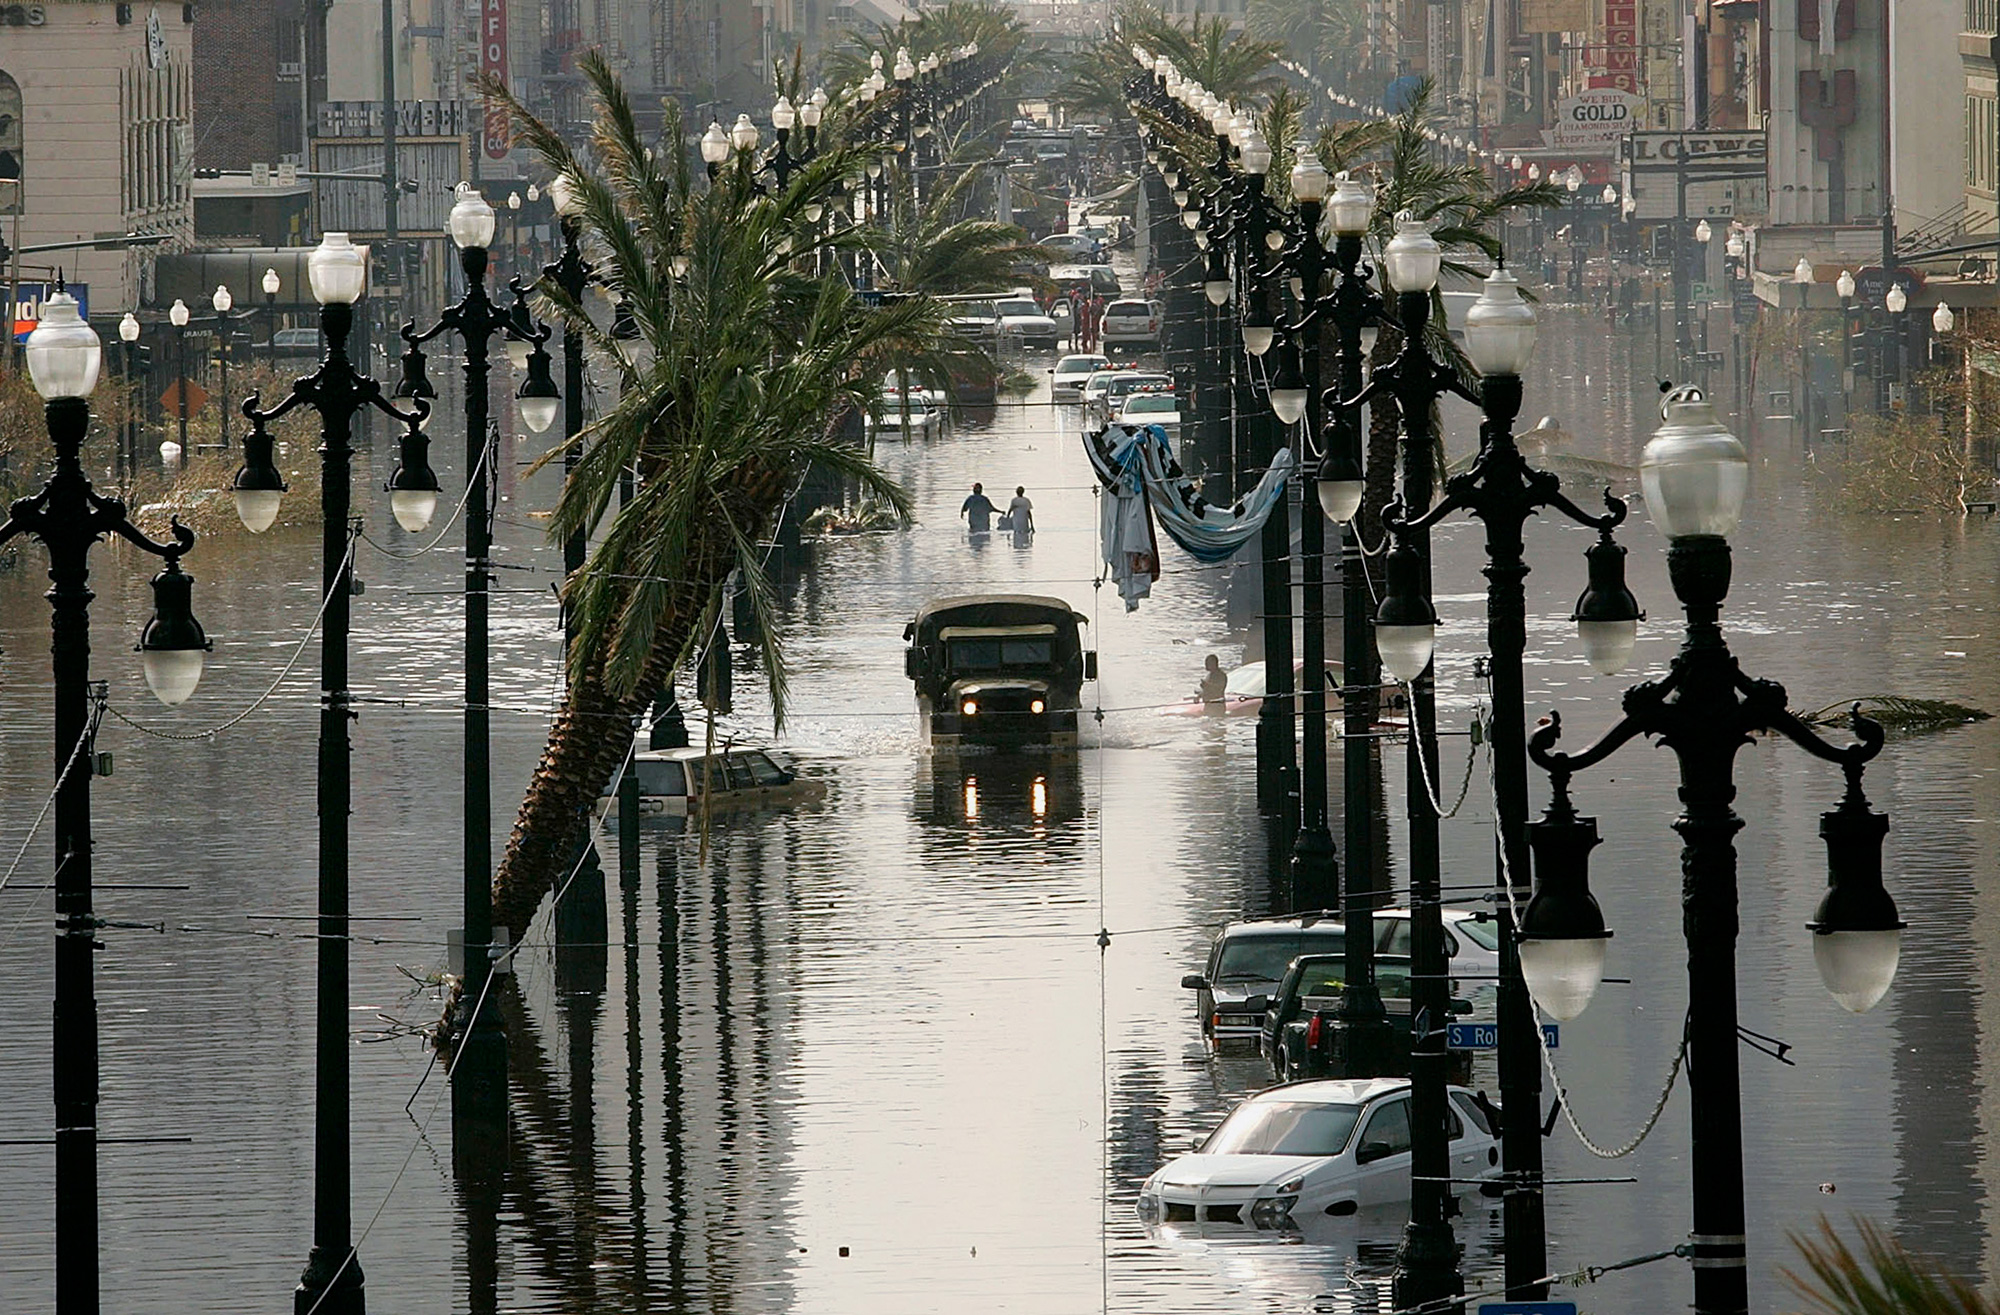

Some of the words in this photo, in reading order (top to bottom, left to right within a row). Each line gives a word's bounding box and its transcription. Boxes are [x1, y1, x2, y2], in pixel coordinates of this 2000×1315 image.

[1579, 95, 1600, 105] WE
[1602, 94, 1625, 104] BUY
[1572, 104, 1627, 122] GOLD
[1636, 139, 1766, 160] LOEWS
[1452, 1027, 1462, 1045] S
